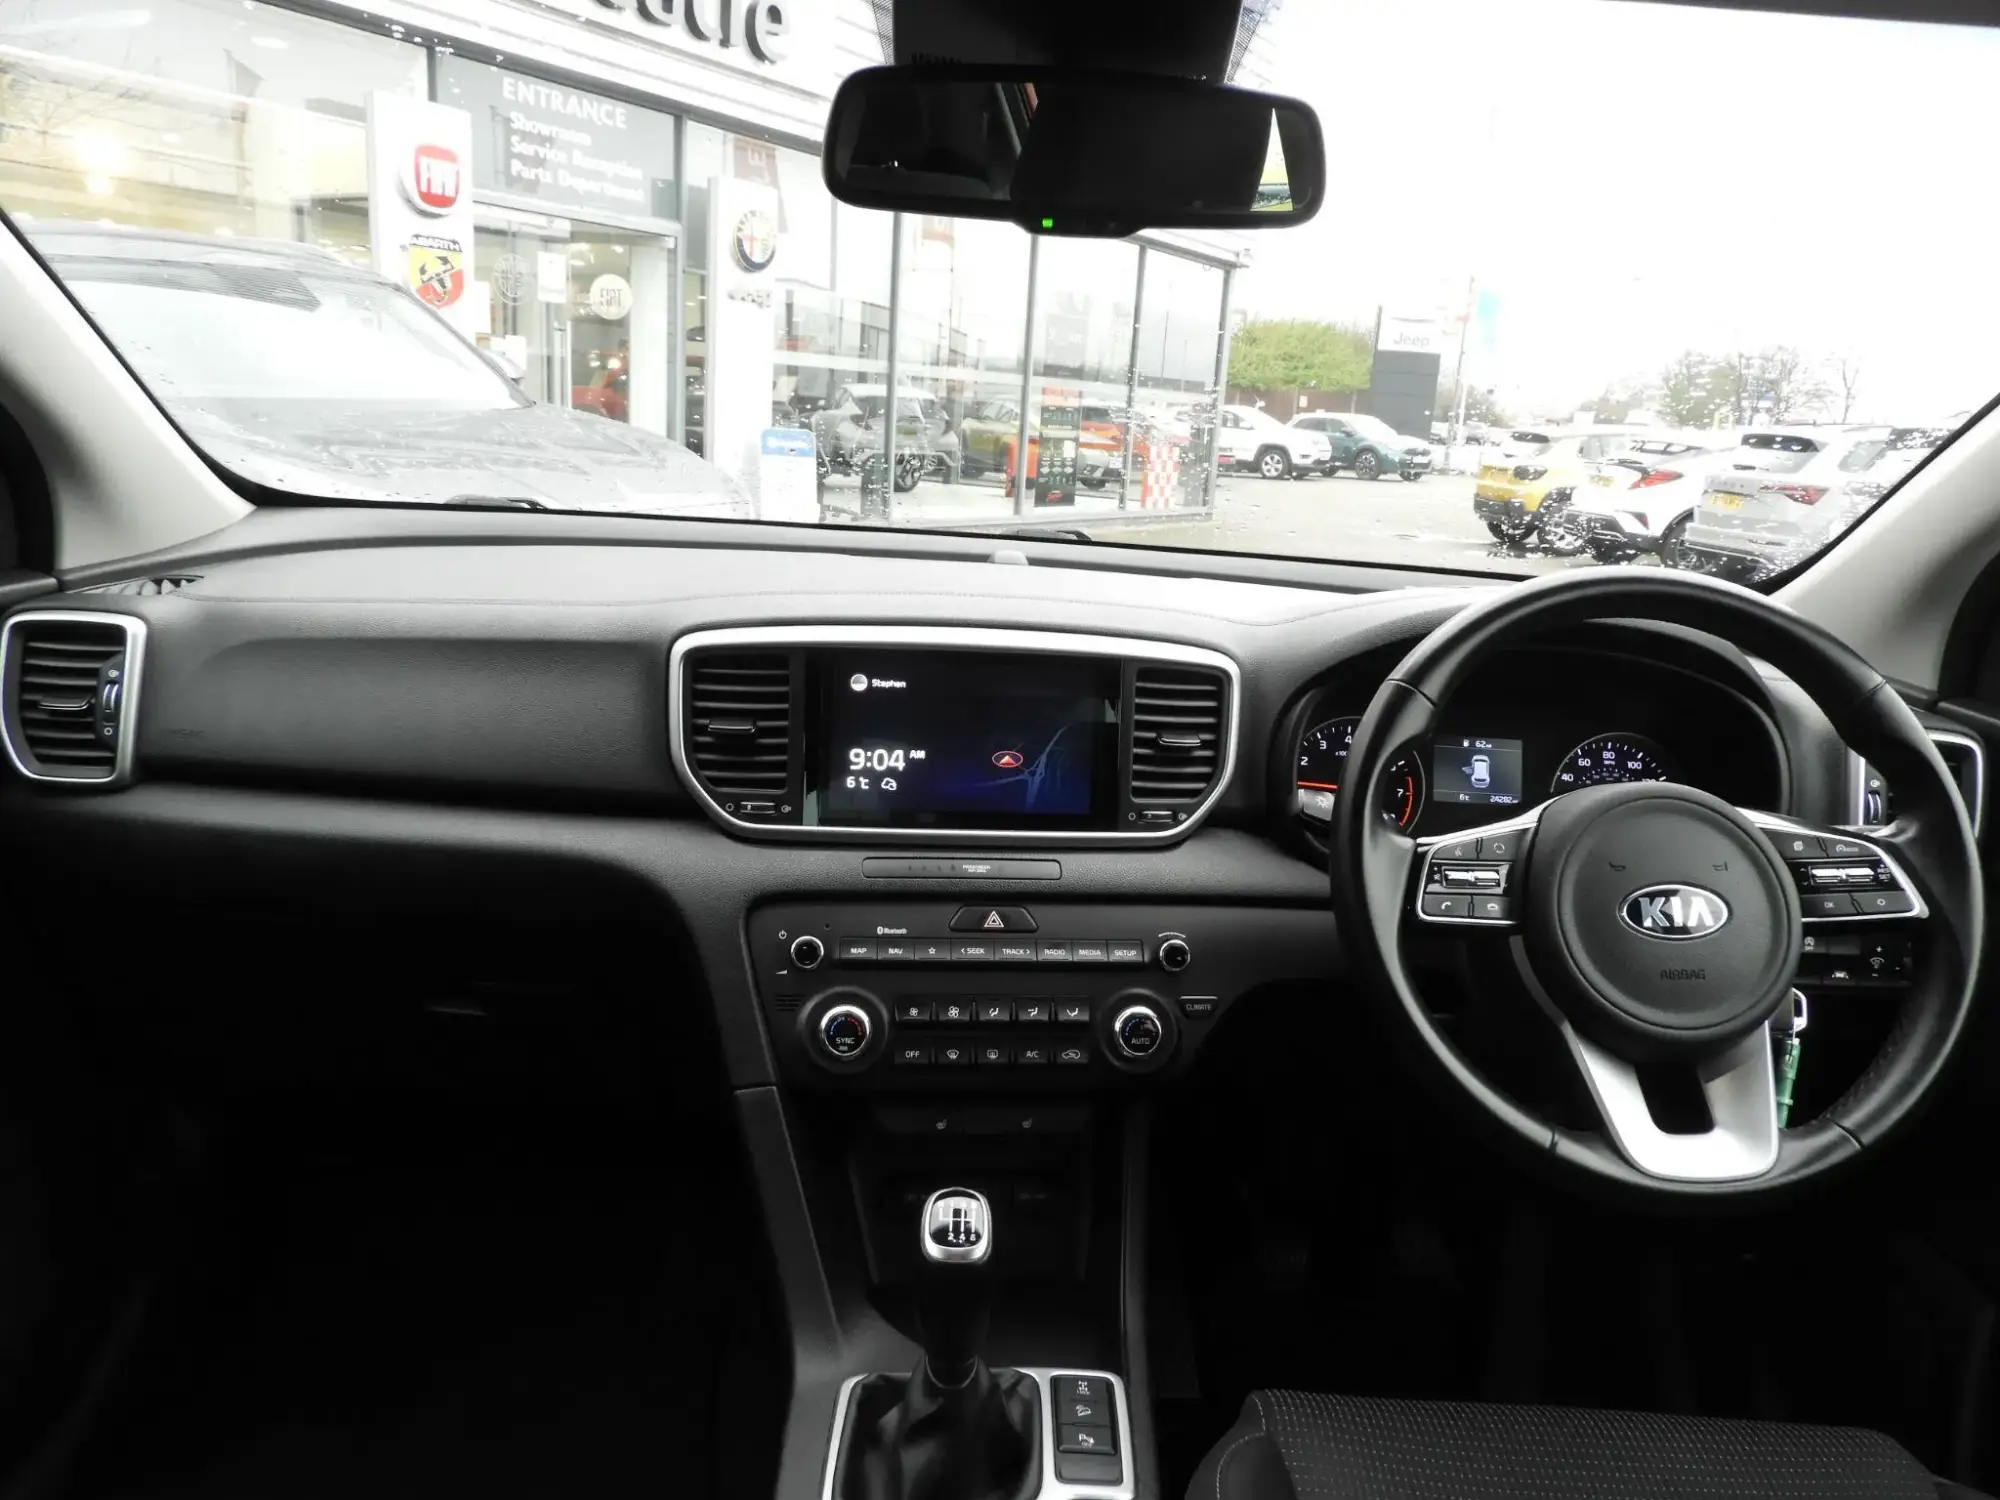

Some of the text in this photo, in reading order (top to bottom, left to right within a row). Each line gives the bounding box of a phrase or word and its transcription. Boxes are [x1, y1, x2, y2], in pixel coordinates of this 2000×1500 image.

[502, 76, 628, 130] ENTRANCE
[510, 135, 568, 165] Service
[510, 158, 553, 183] Parts
[1392, 331, 1430, 349] Jeep
[871, 678, 907, 689] Stephen
[849, 748, 926, 771] 9:04 AM
[1602, 751, 1615, 760] 80
[1300, 756, 1309, 766] 2
[1578, 758, 1591, 767] 60
[1627, 761, 1643, 770] 100
[1561, 773, 1574, 782] 40
[1638, 896, 1715, 927] KIA
[888, 947, 903, 955] NAV
[966, 947, 985, 955] SEEK
[1044, 948, 1066, 956] RADIO
[1078, 949, 1102, 957] MEDIA
[1660, 968, 1706, 980] AIRBAG
[1186, 1003, 1212, 1011] CLIMATE
[835, 1037, 855, 1045] SYNC
[1131, 1037, 1150, 1045] AUTO
[905, 1050, 920, 1058] OFF
[1026, 1050, 1039, 1058] A/C
